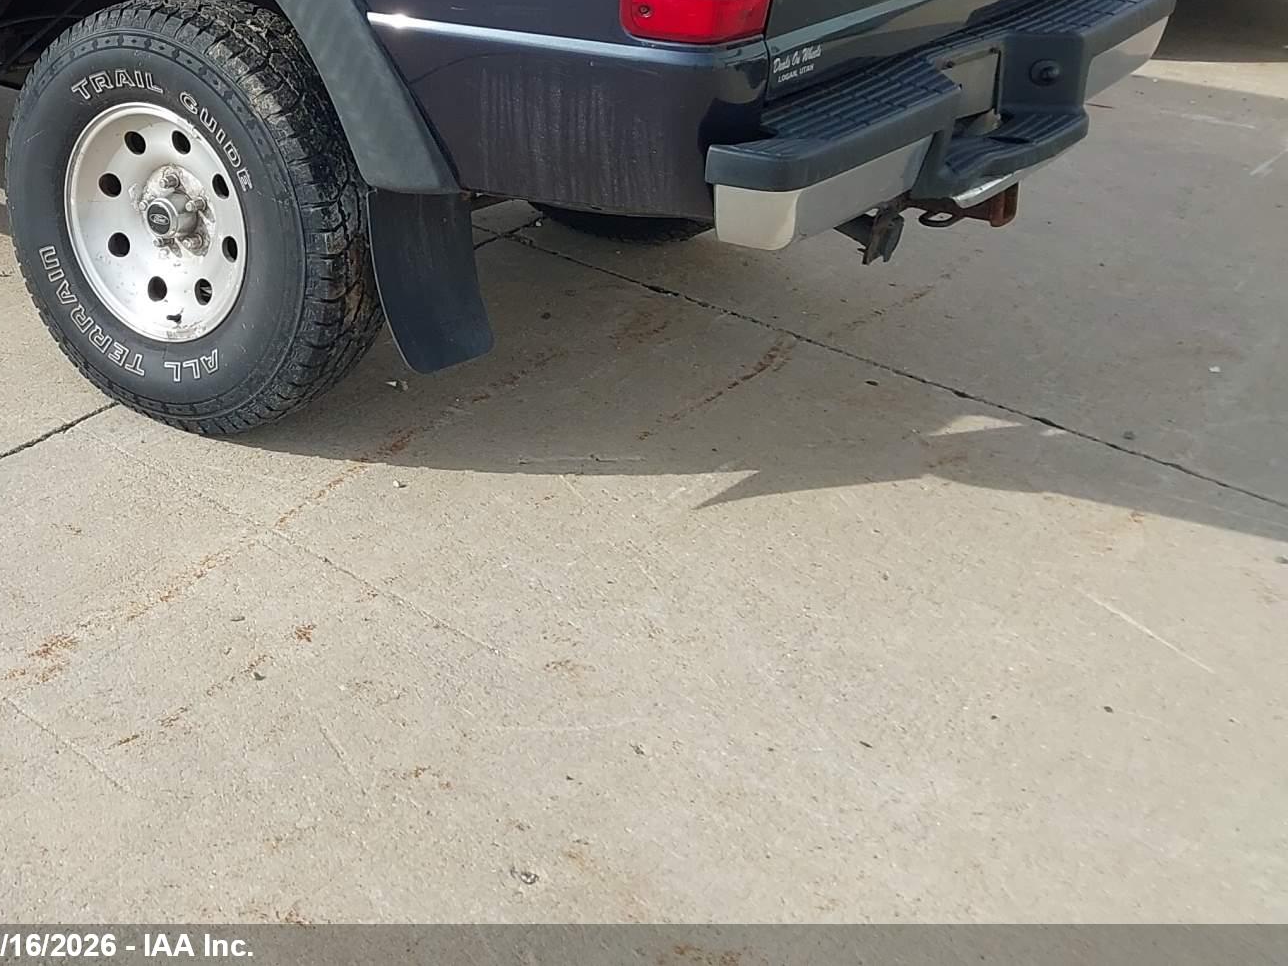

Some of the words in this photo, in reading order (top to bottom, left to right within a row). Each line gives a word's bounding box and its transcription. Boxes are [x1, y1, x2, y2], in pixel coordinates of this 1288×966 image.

[71, 68, 164, 101] TRAIL
[179, 92, 253, 193] GUIDE
[39, 245, 146, 377] TERRAIN
[164, 348, 221, 383] ALL
